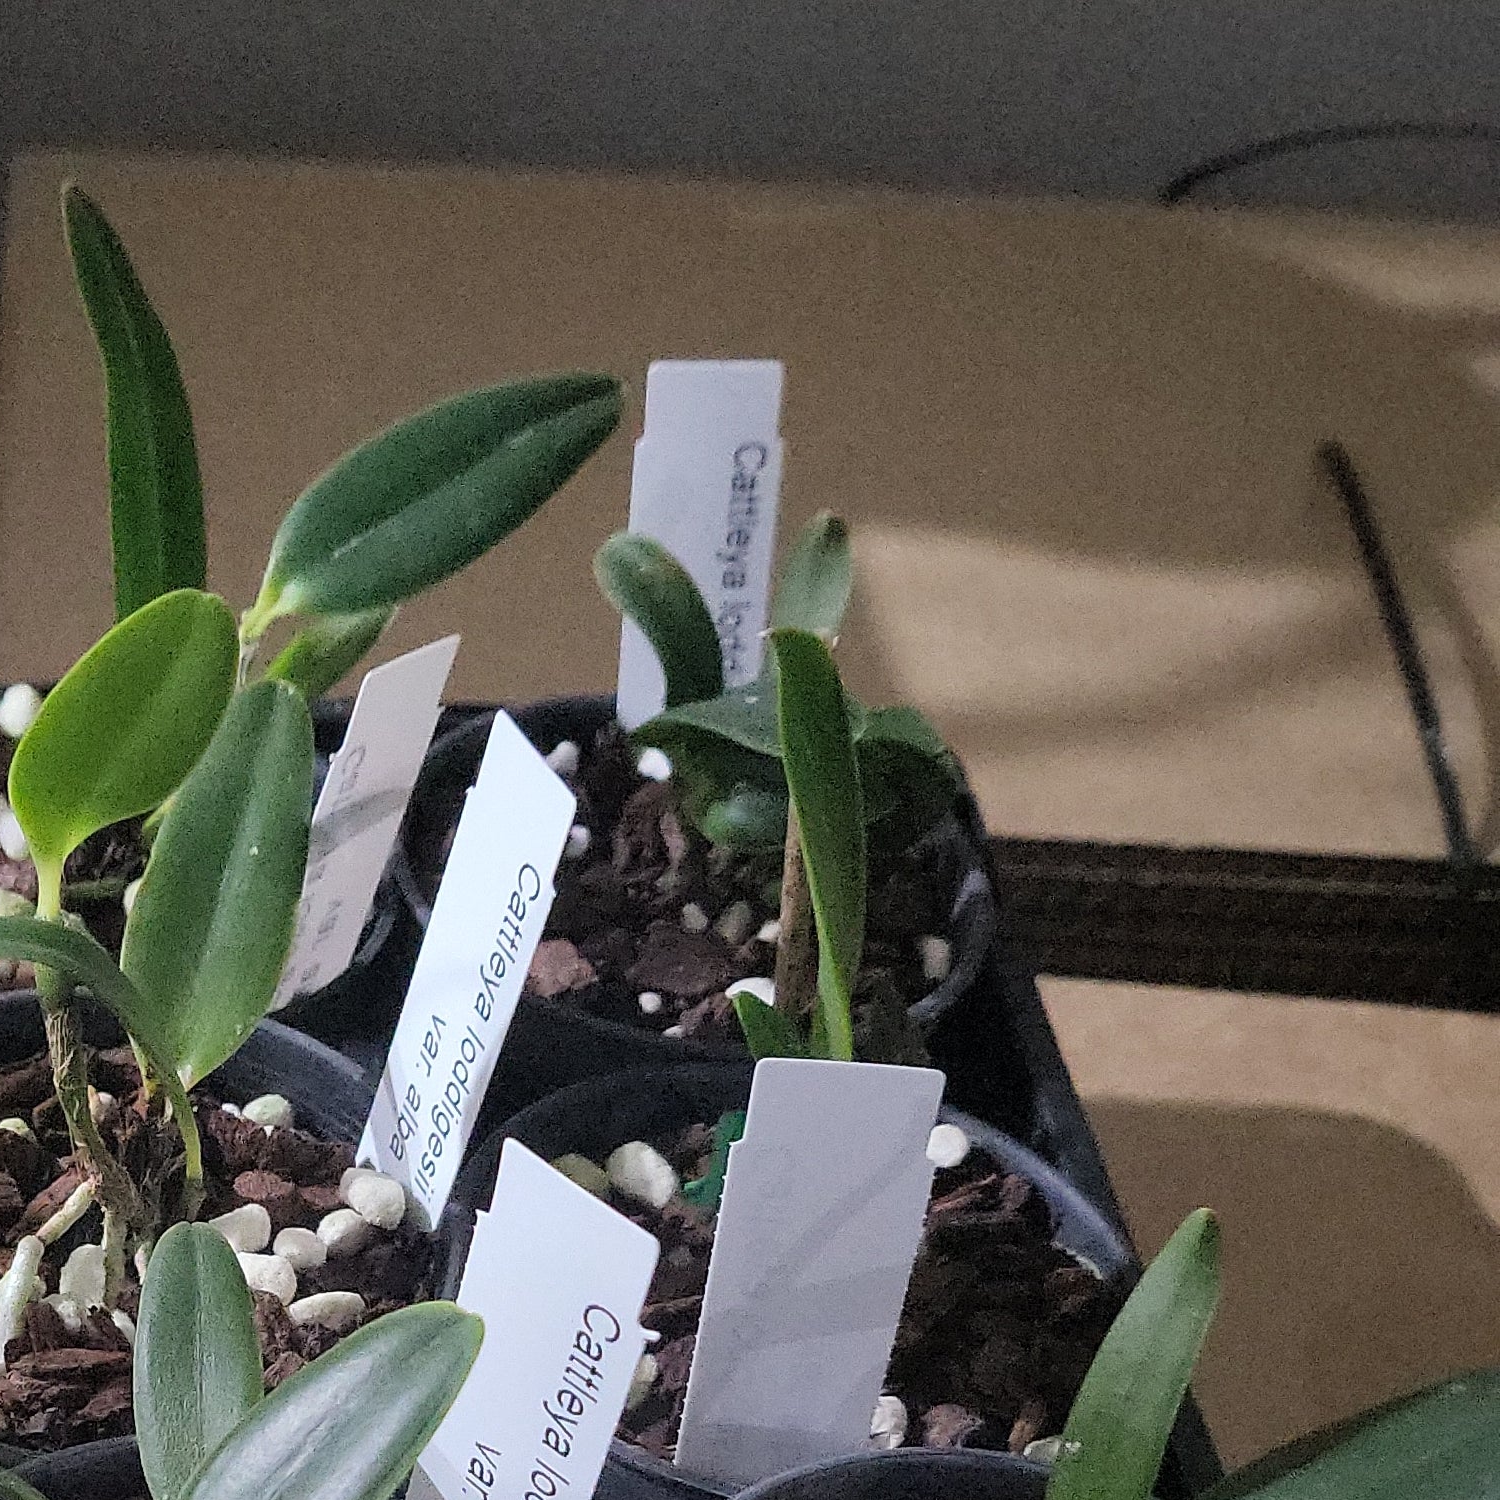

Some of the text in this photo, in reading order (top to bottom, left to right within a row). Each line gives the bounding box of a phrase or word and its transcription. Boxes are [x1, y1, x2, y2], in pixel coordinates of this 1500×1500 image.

[390, 1014, 447, 1161] var. alba
[416, 863, 540, 1202] Cattleya loddigesii
[543, 1305, 620, 1458] Cattleya
